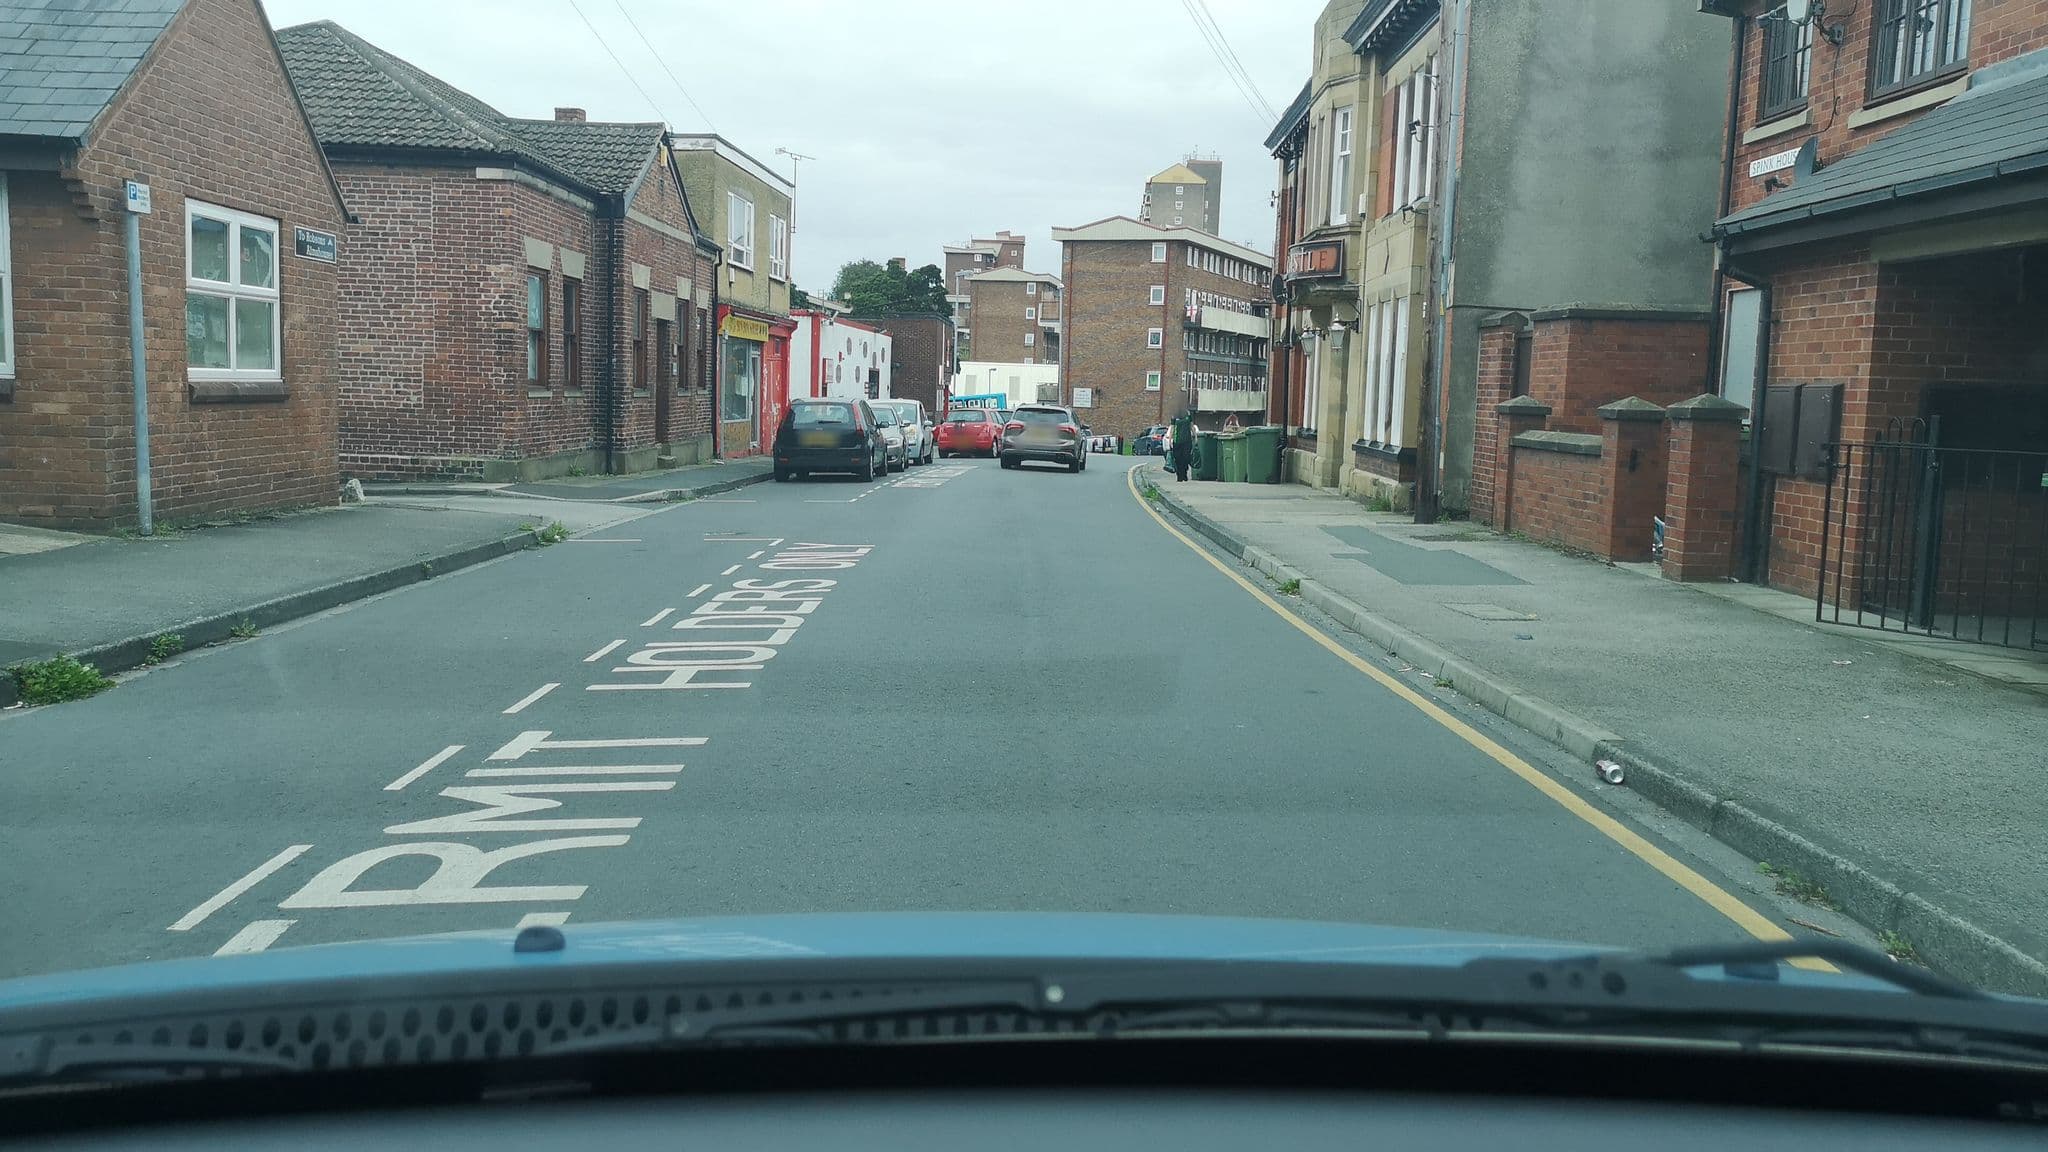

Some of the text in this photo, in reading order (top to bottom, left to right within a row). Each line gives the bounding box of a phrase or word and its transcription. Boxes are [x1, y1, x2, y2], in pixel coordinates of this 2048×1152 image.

[1752, 151, 1798, 175] SPINK HOUS
[213, 542, 876, 956] RMIT HOLDERS ONLY
